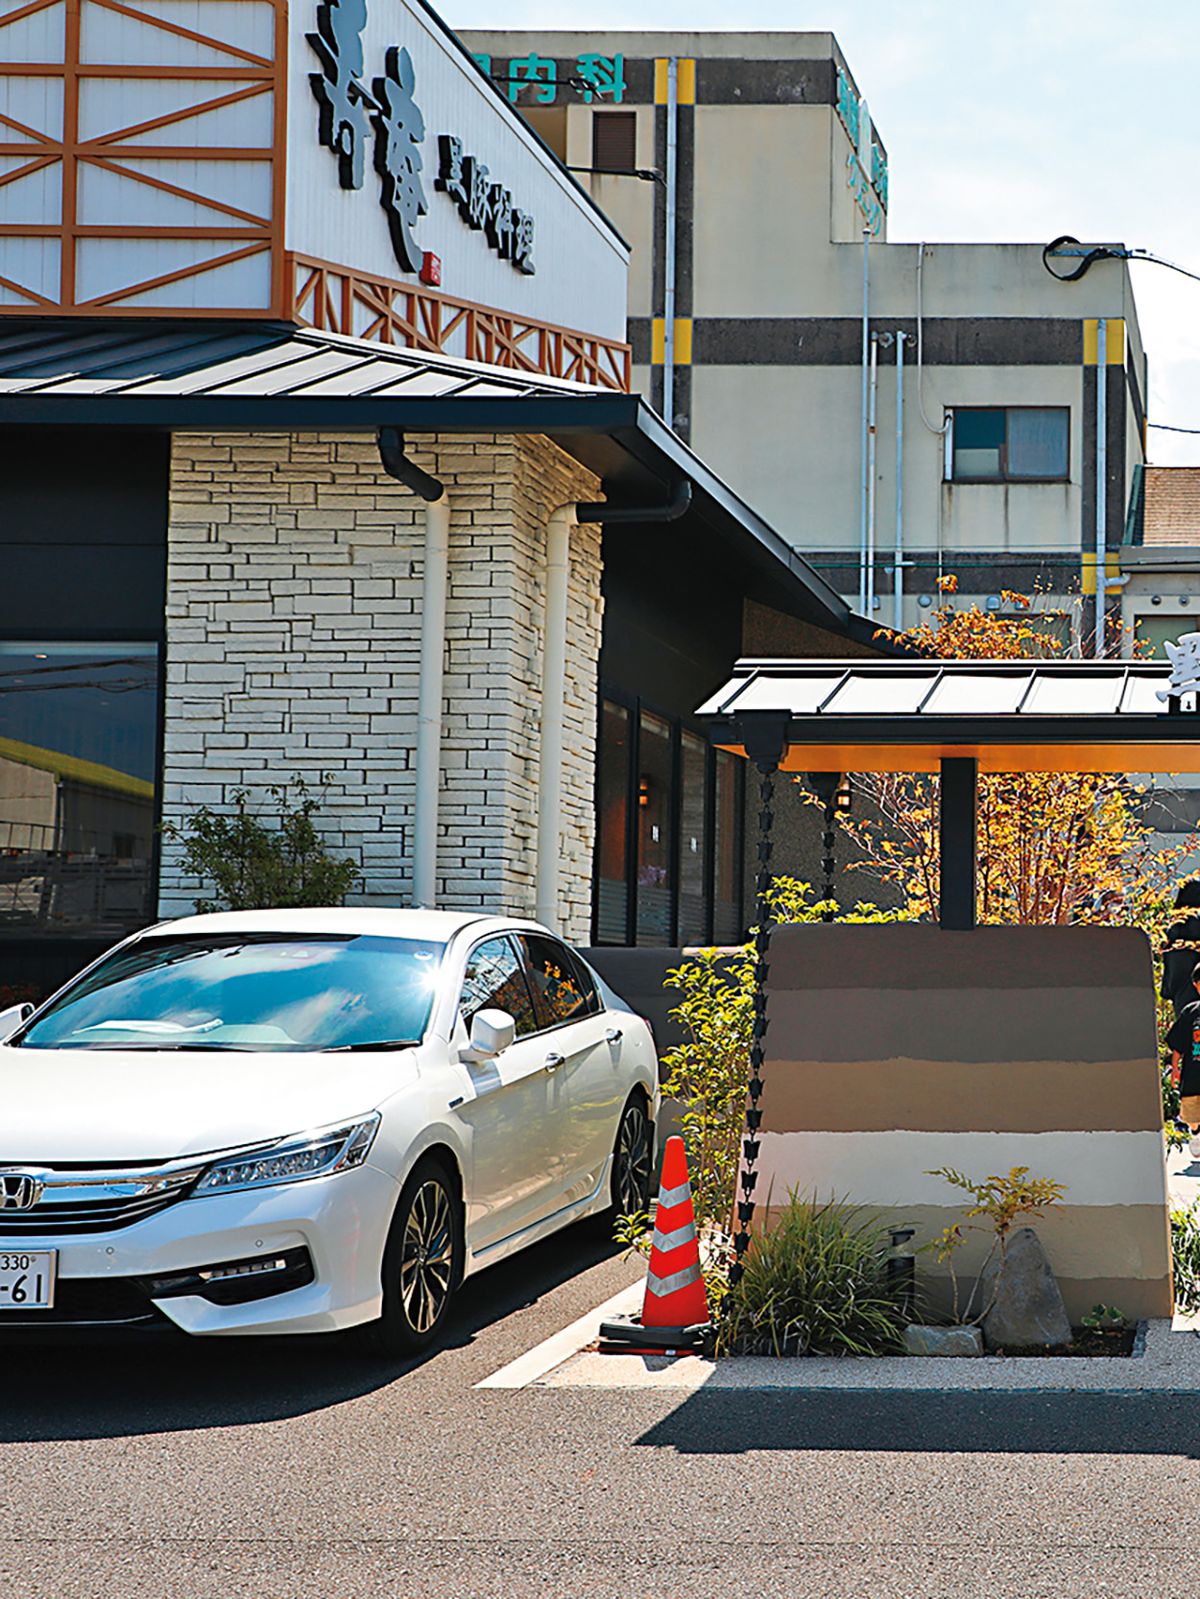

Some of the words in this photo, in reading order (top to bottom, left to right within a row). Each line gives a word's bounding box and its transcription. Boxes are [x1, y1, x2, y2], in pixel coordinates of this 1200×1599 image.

[434, 135, 535, 275] 黒豚料理
[0, 1255, 30, 1271] 330
